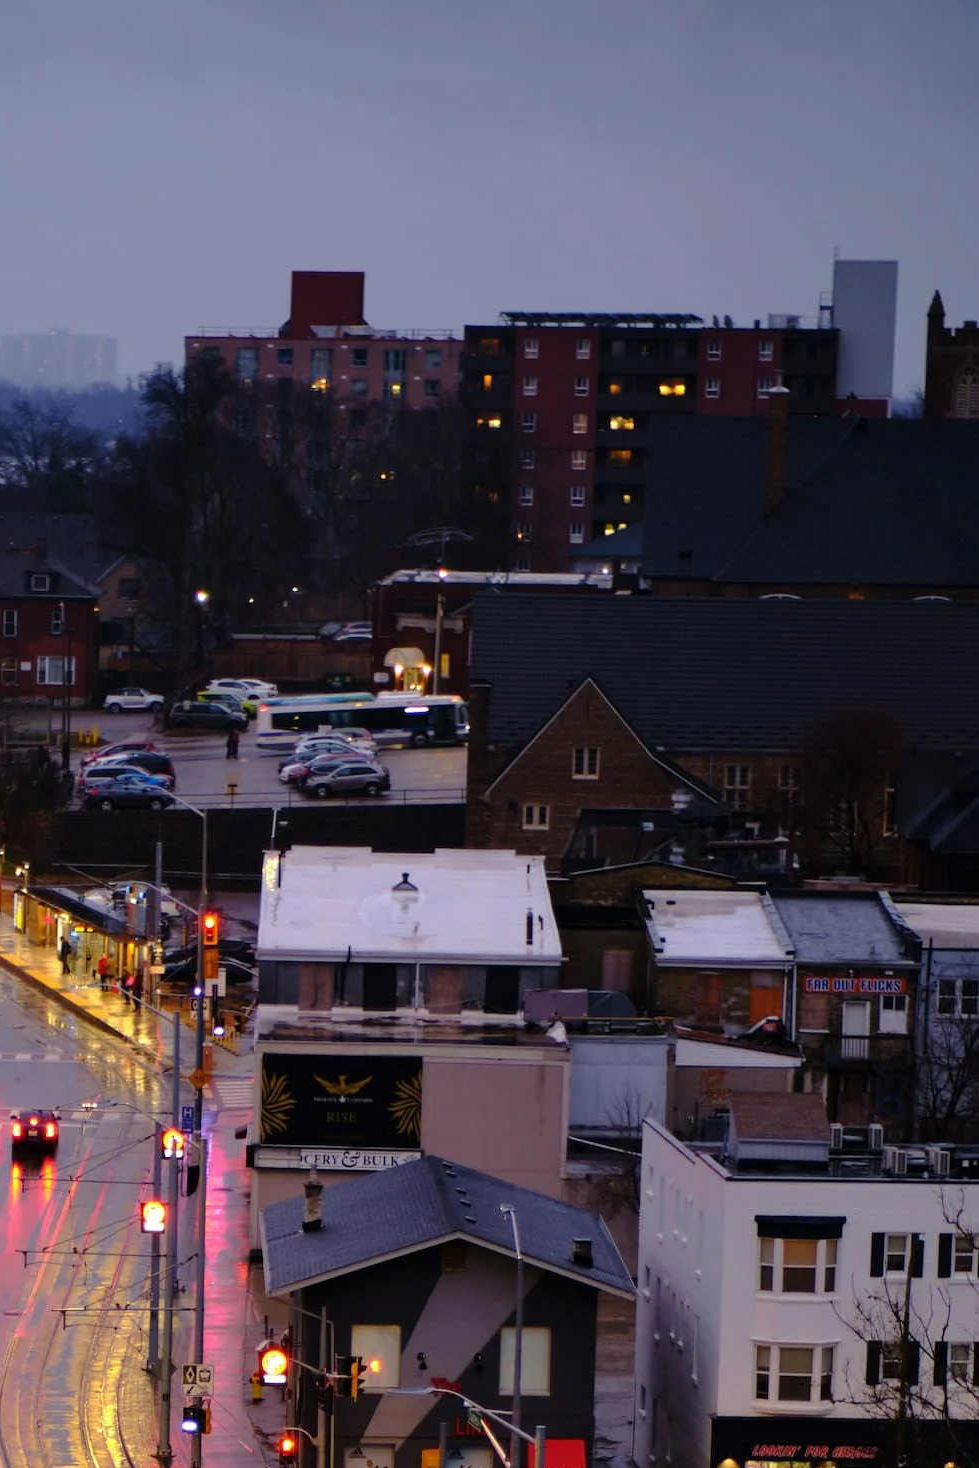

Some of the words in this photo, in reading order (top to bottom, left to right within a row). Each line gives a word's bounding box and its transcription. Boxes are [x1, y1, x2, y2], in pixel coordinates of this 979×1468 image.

[806, 978, 830, 992] FAR
[833, 978, 857, 992] OUT
[860, 979, 902, 993] FLICKS
[326, 1111, 357, 1123] RISE
[342, 1150, 360, 1168] &
[363, 1154, 399, 1167] BULK
[752, 1444, 800, 1457] LOOKIN'
[804, 1445, 830, 1458] FOR
